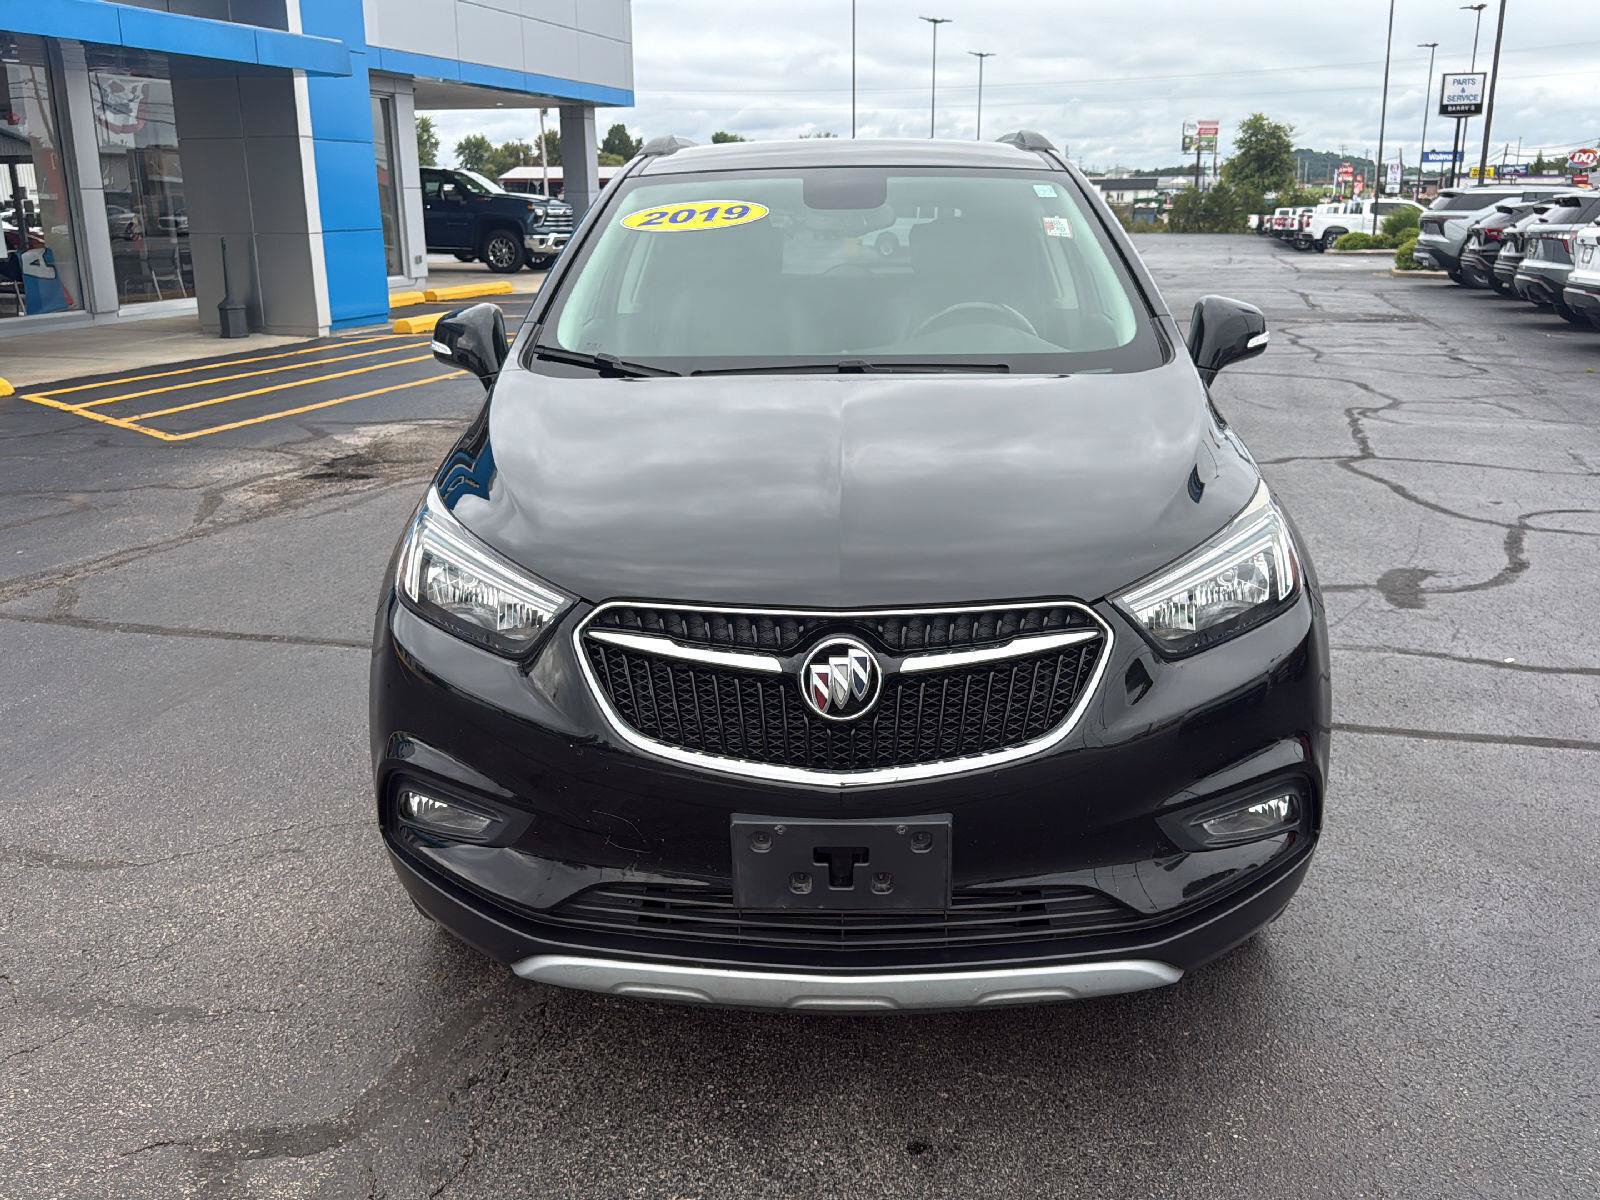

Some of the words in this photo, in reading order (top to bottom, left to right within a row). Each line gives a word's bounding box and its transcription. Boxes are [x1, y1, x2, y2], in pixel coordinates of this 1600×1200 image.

[1453, 78, 1476, 86] PARTS
[1447, 94, 1479, 102] SERVICE
[1573, 152, 1595, 163] DQ
[637, 205, 751, 227] 2019
